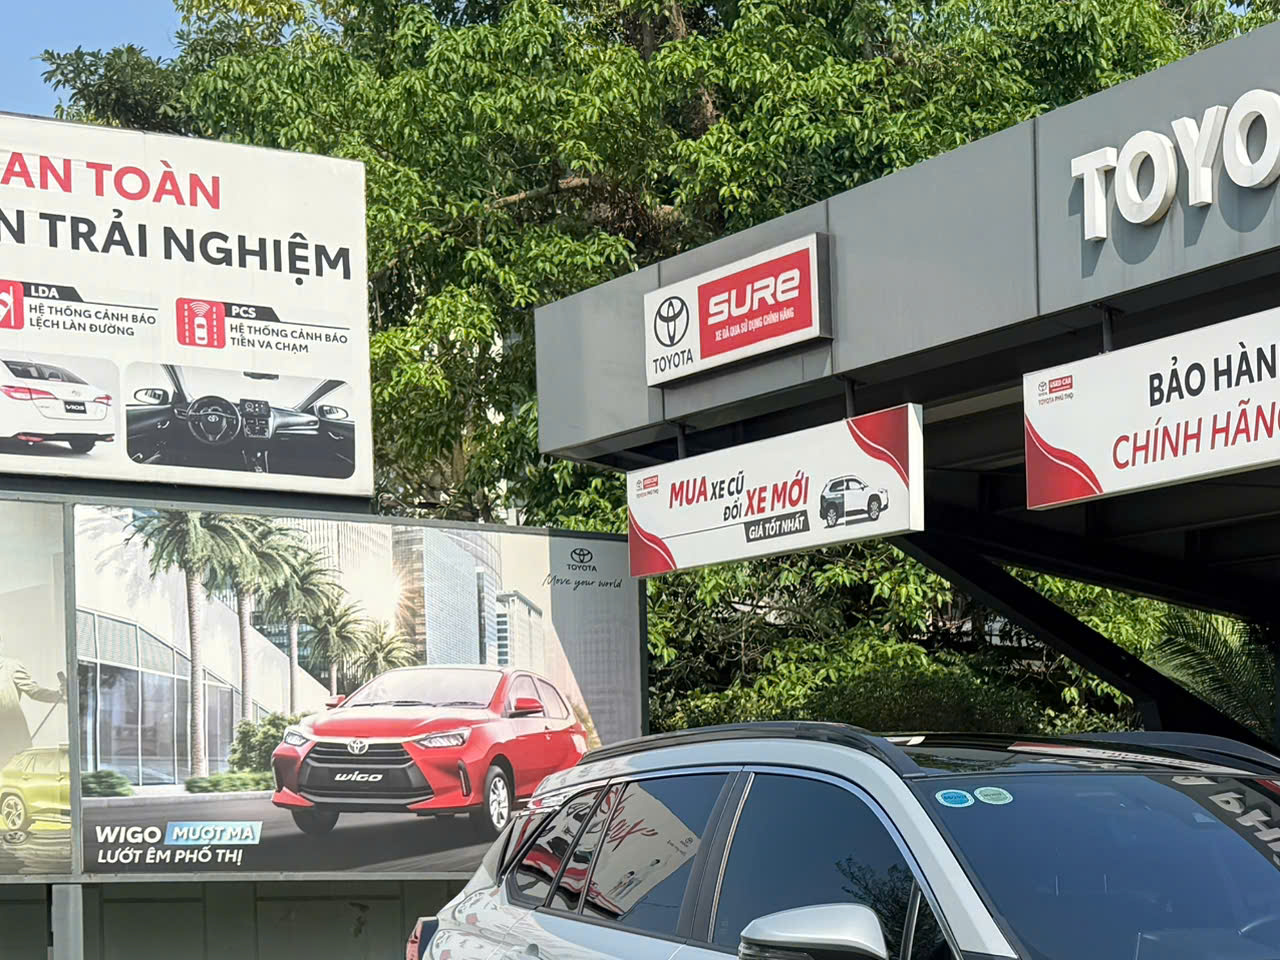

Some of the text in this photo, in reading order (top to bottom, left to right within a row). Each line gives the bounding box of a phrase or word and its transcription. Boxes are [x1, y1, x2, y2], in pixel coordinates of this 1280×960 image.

[1, 151, 220, 210] AN TOÀN
[39, 208, 147, 257] TRẢI
[163, 226, 351, 286] NGHIỆM
[31, 285, 59, 299] LDA
[29, 303, 156, 325] HỆ THỐNG CẢNH BÁO
[231, 305, 256, 318] PCS
[30, 316, 135, 336] LỆCH LÀN ĐƯỜNG
[247, 324, 288, 339] THỐNG
[291, 330, 322, 342] CẢNH
[325, 333, 348, 344] BÁO
[715, 330, 722, 341] XE
[730, 324, 740, 337] QUA
[748, 316, 762, 332] DỤNG
[763, 311, 779, 326] CHÍNH
[780, 307, 795, 321] HÃNG
[230, 334, 309, 355] TIỀN VA CHẠM
[653, 348, 694, 374] TOYOTA
[1149, 355, 1206, 407] BẢO
[1112, 416, 1203, 470] CHÍNH
[669, 475, 708, 509] MUA
[710, 480, 725, 501] XE
[727, 470, 745, 497] CŨ
[723, 470, 810, 521] ĐỔI XE MỚI
[749, 513, 805, 539] GIÁ TỐT NHẤT
[567, 564, 597, 572] TOYOTA
[542, 572, 623, 591] Move your world
[96, 825, 162, 844] WIGO
[97, 843, 243, 866] LƯỚT ÊM PHỐ THỊ
